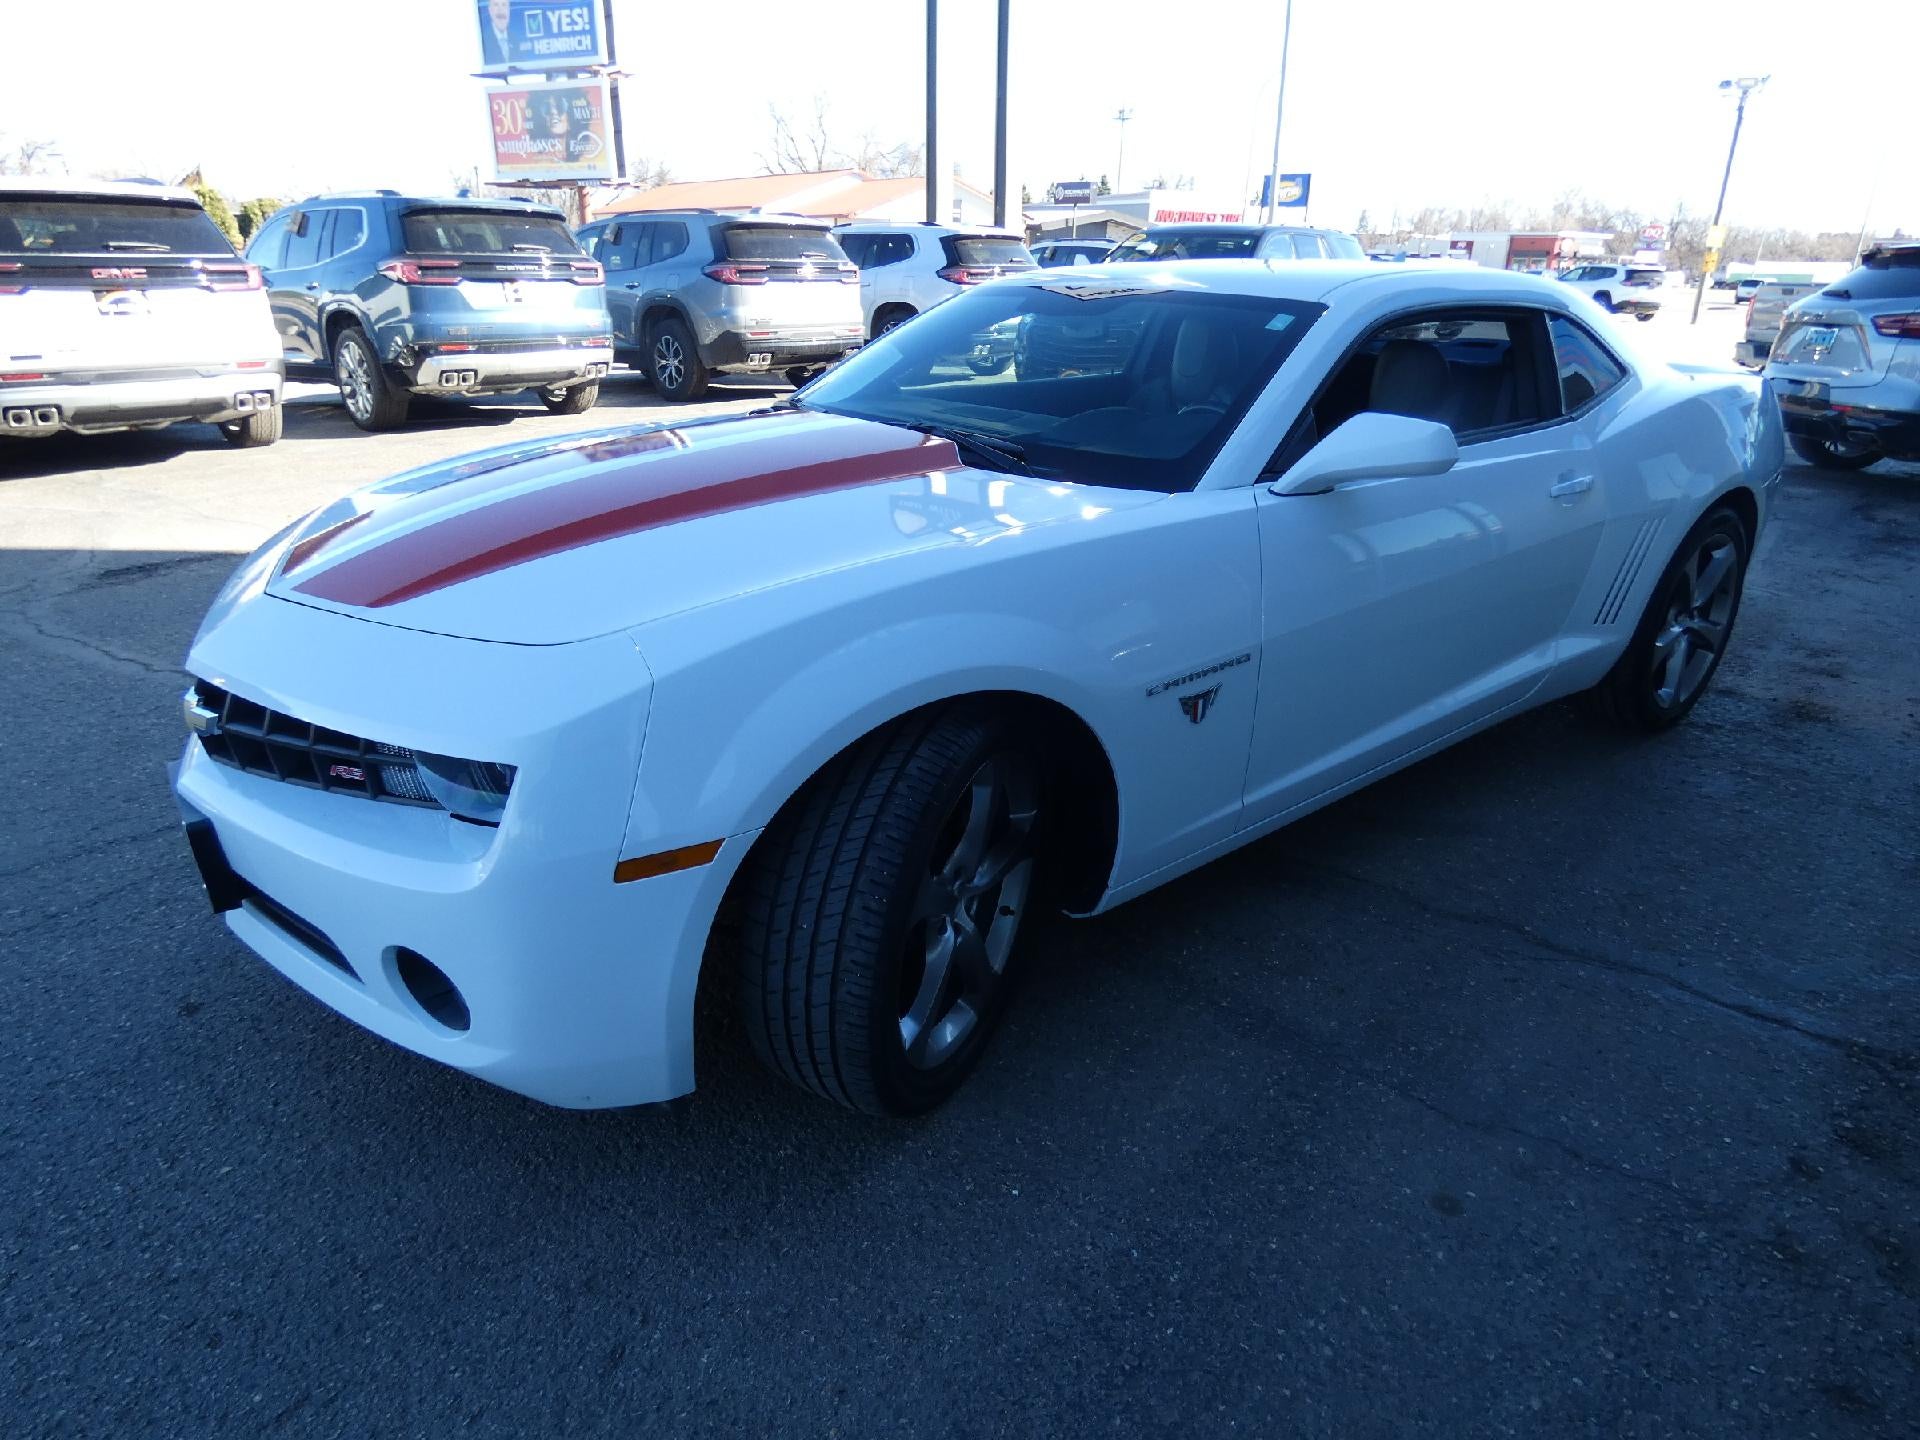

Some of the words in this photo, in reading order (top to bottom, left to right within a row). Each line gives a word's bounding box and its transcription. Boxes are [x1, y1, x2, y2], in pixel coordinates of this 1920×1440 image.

[546, 7, 591, 33] YES!
[533, 35, 592, 55] HEINRICH
[573, 106, 592, 120] MAY
[91, 268, 147, 279] GMC
[1145, 653, 1251, 697] CAMARO
[330, 764, 366, 781] RS
